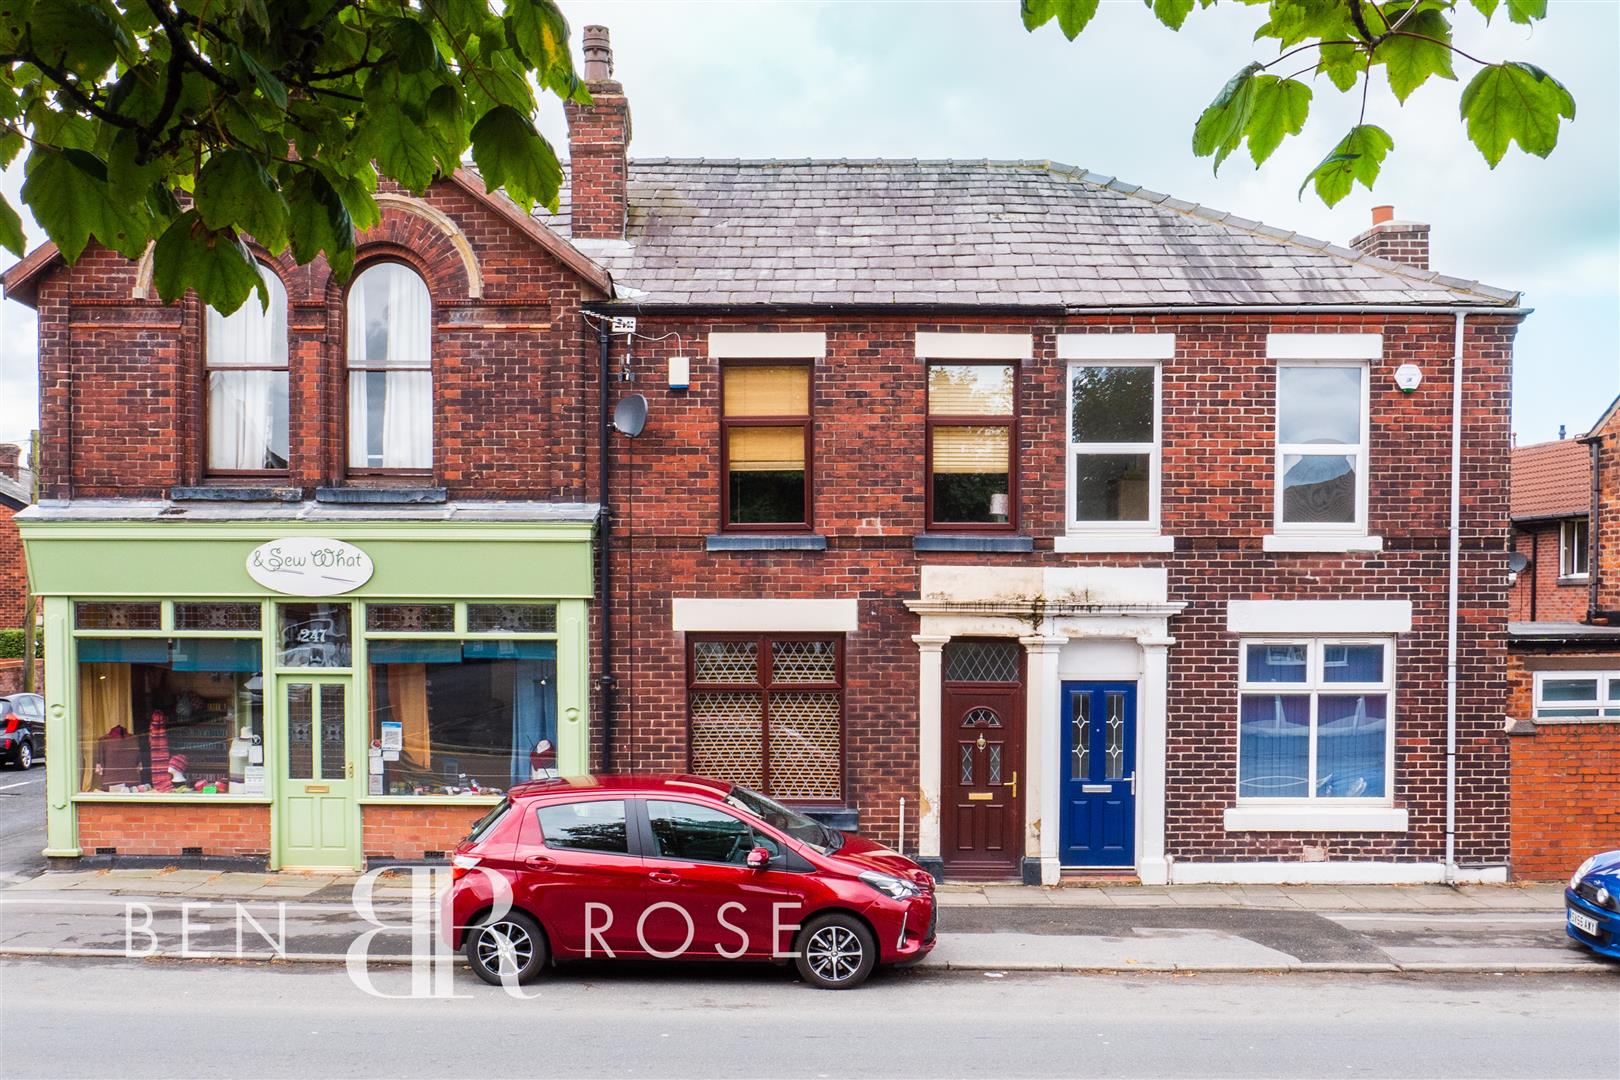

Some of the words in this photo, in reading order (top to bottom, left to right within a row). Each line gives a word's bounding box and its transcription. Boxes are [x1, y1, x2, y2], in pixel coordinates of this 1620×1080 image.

[253, 550, 264, 568] &
[268, 547, 307, 569] Sew
[311, 548, 362, 568] What
[299, 628, 328, 643] 247
